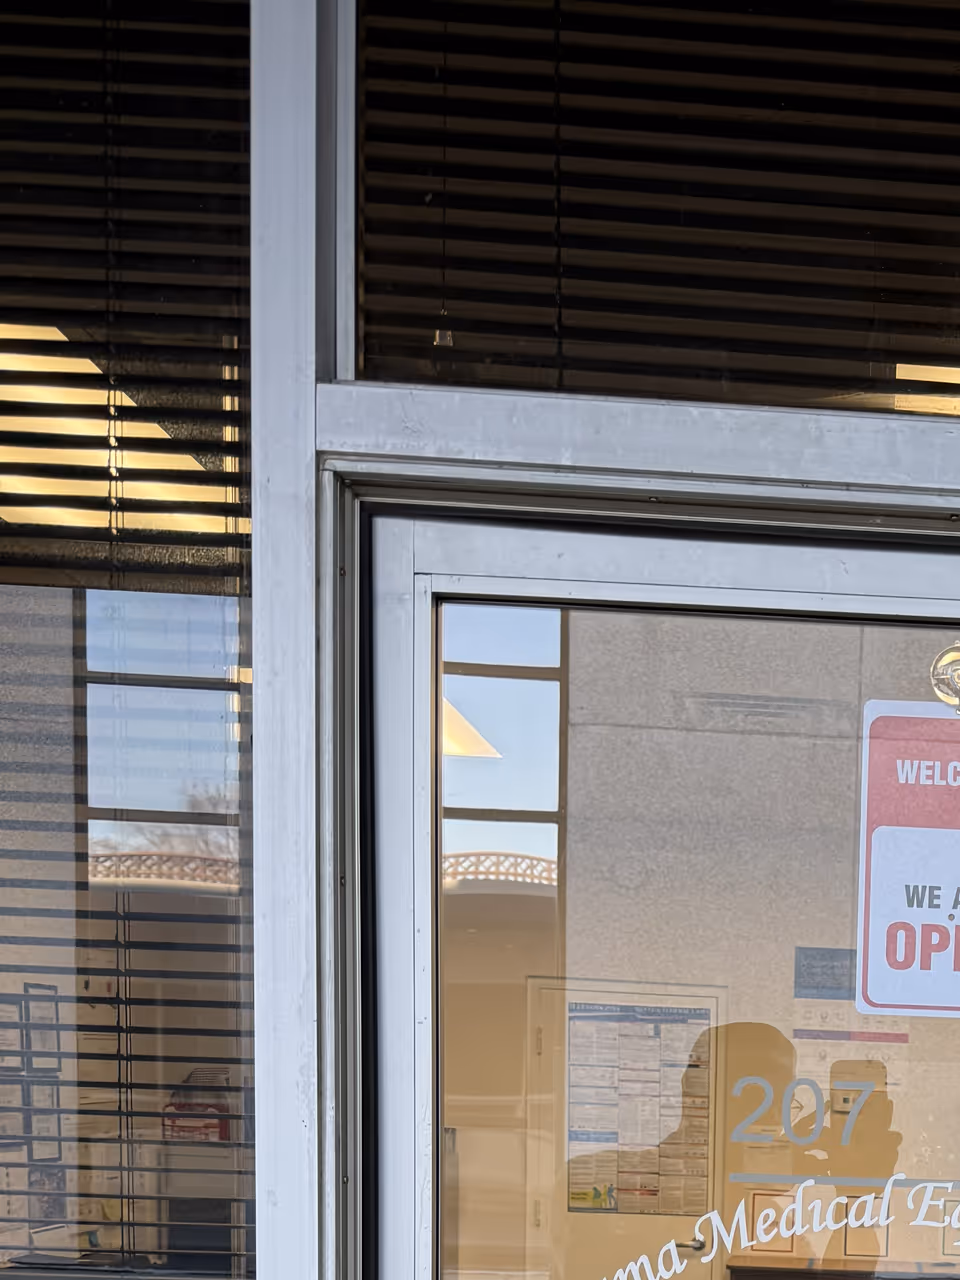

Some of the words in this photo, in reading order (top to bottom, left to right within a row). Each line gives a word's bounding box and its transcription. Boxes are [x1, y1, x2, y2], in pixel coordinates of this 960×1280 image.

[904, 884, 942, 909] WE
[730, 1076, 876, 1146] 207
[695, 1173, 908, 1264] Medical
